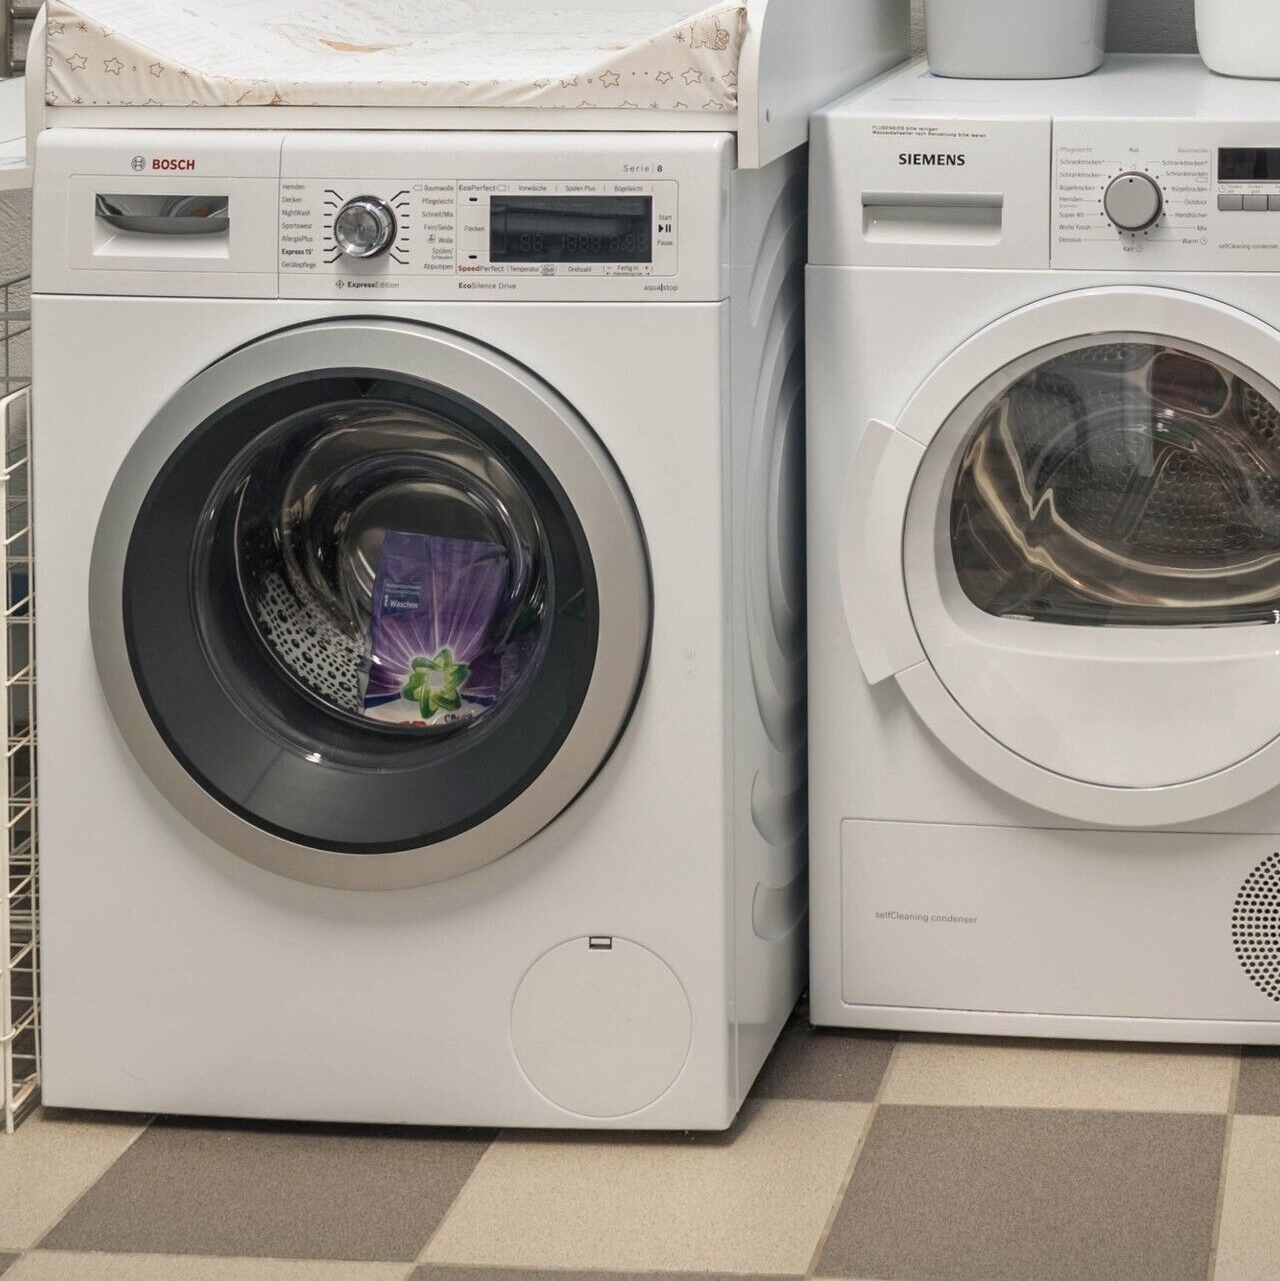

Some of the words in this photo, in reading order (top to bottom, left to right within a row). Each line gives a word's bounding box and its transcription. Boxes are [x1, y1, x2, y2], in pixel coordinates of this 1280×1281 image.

[898, 153, 966, 166] SIEMENS
[152, 159, 195, 170] BOSCH
[623, 164, 650, 173] Serie
[281, 248, 304, 256] Express
[347, 281, 399, 289] ExpressEdition
[390, 600, 419, 609] Waschen
[874, 911, 929, 923] selfCleaning
[931, 914, 977, 924] condenser
